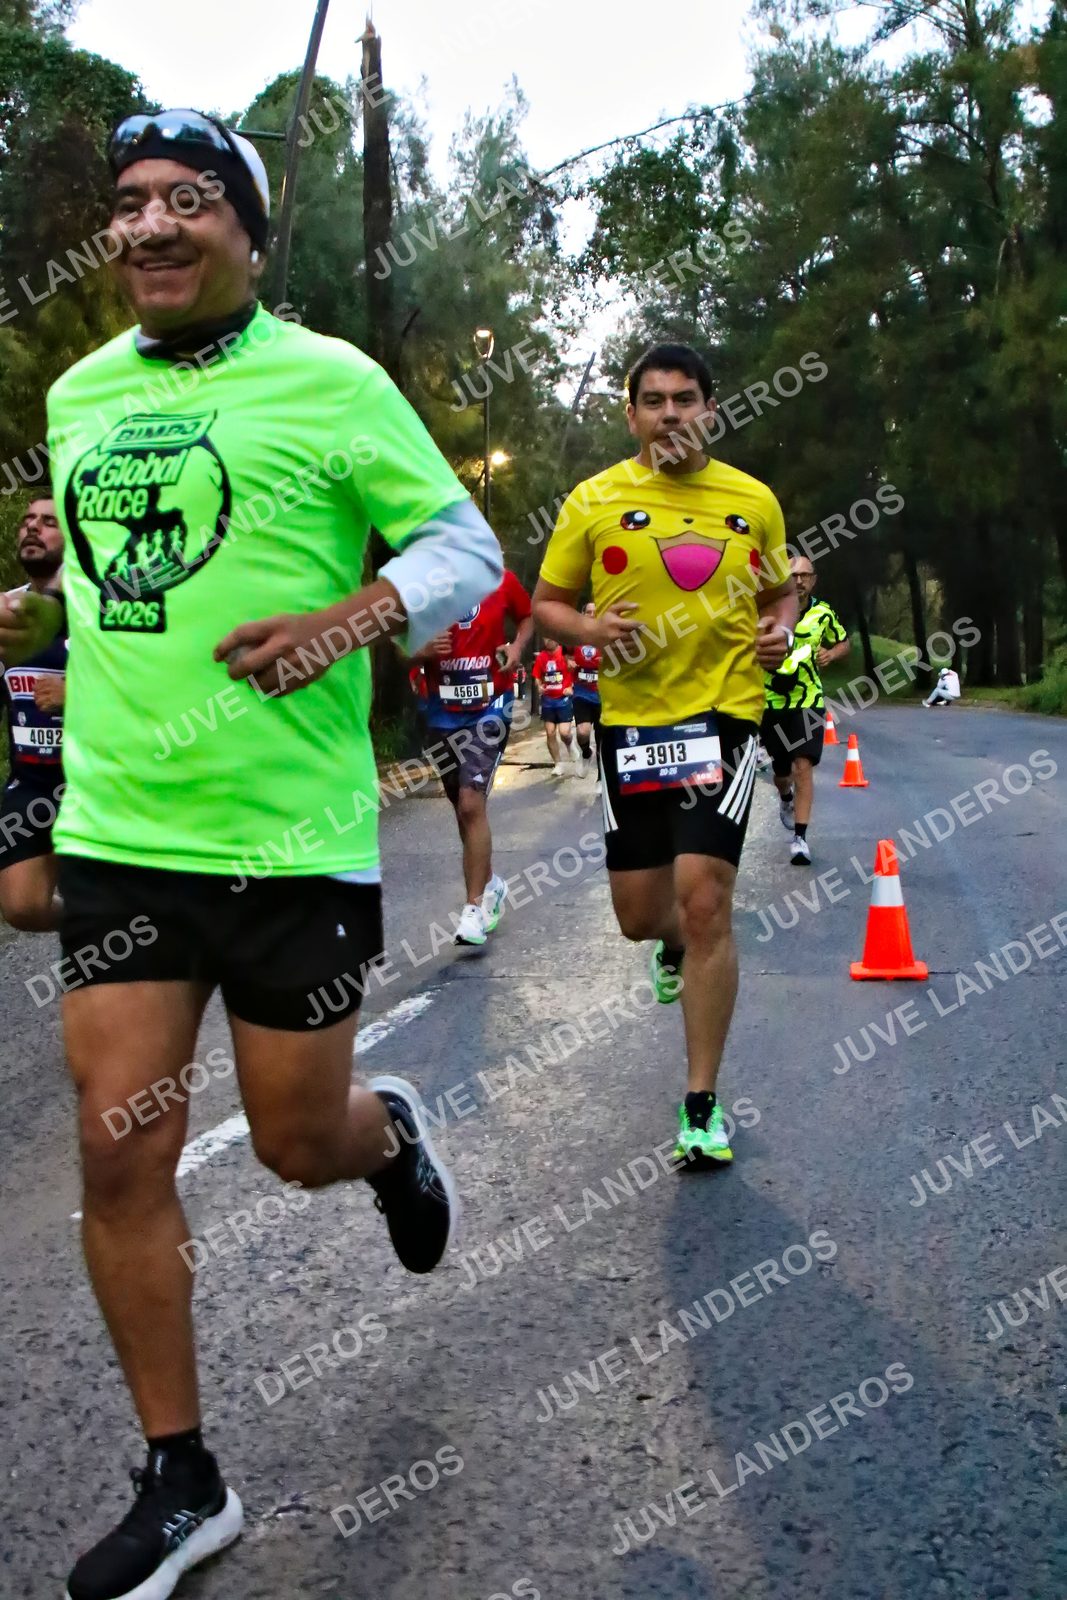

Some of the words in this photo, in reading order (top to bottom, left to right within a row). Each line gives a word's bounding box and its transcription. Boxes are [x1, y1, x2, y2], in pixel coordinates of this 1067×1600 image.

[97, 449, 189, 489] Global
[78, 485, 149, 520] Race
[103, 599, 160, 627] 2026
[454, 685, 479, 698] 4568
[30, 728, 63, 745] 4092
[646, 742, 687, 766] 3913
